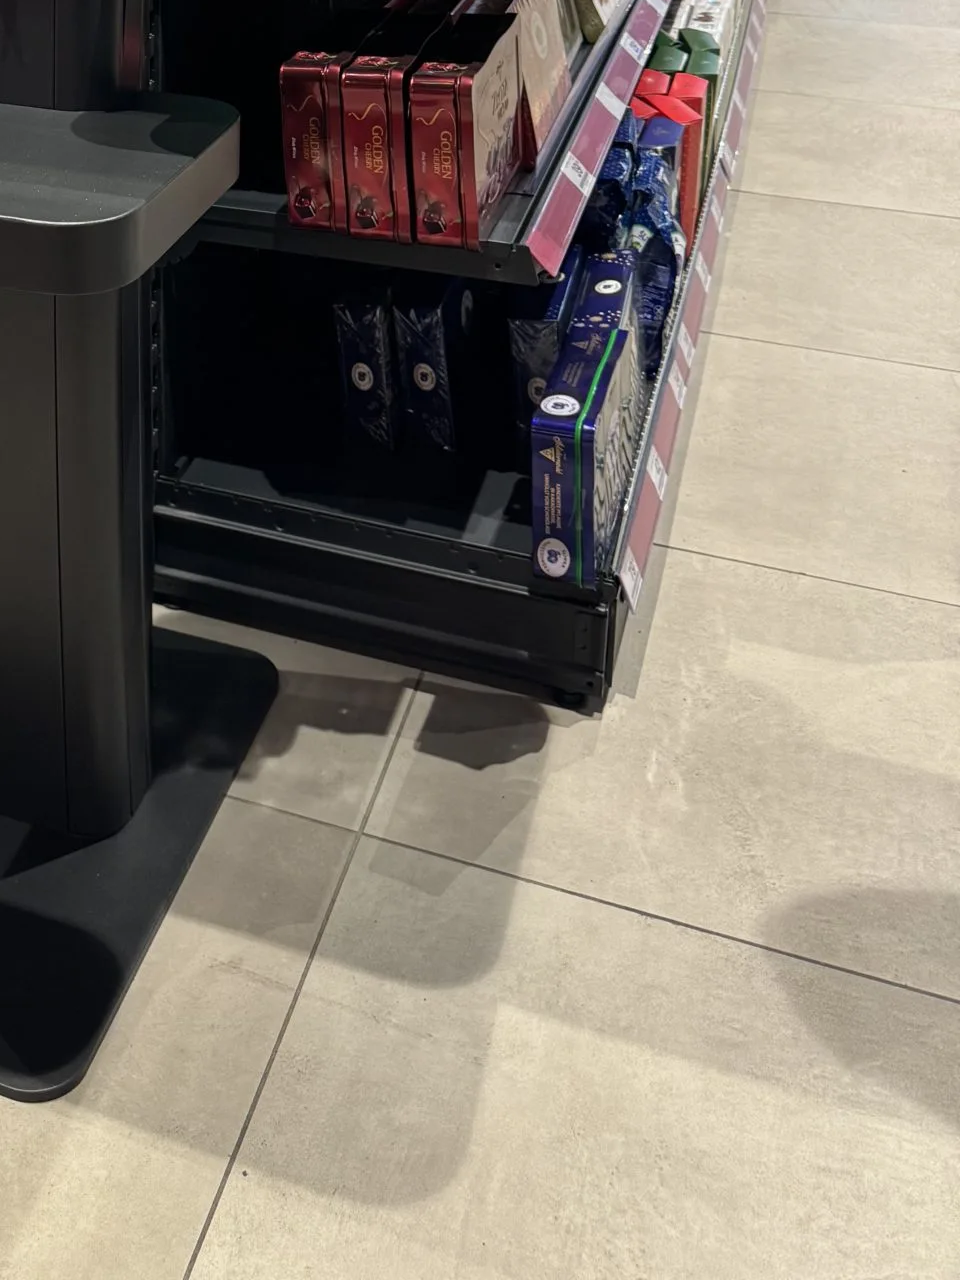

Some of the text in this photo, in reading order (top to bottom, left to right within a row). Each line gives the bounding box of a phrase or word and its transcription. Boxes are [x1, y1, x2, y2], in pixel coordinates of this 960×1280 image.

[309, 116, 321, 165] GOLDEN
[364, 142, 373, 170] CHERRY
[371, 125, 384, 174] GOLDEN
[432, 148, 441, 176] CHERRY
[440, 130, 453, 180] GOLDEN
